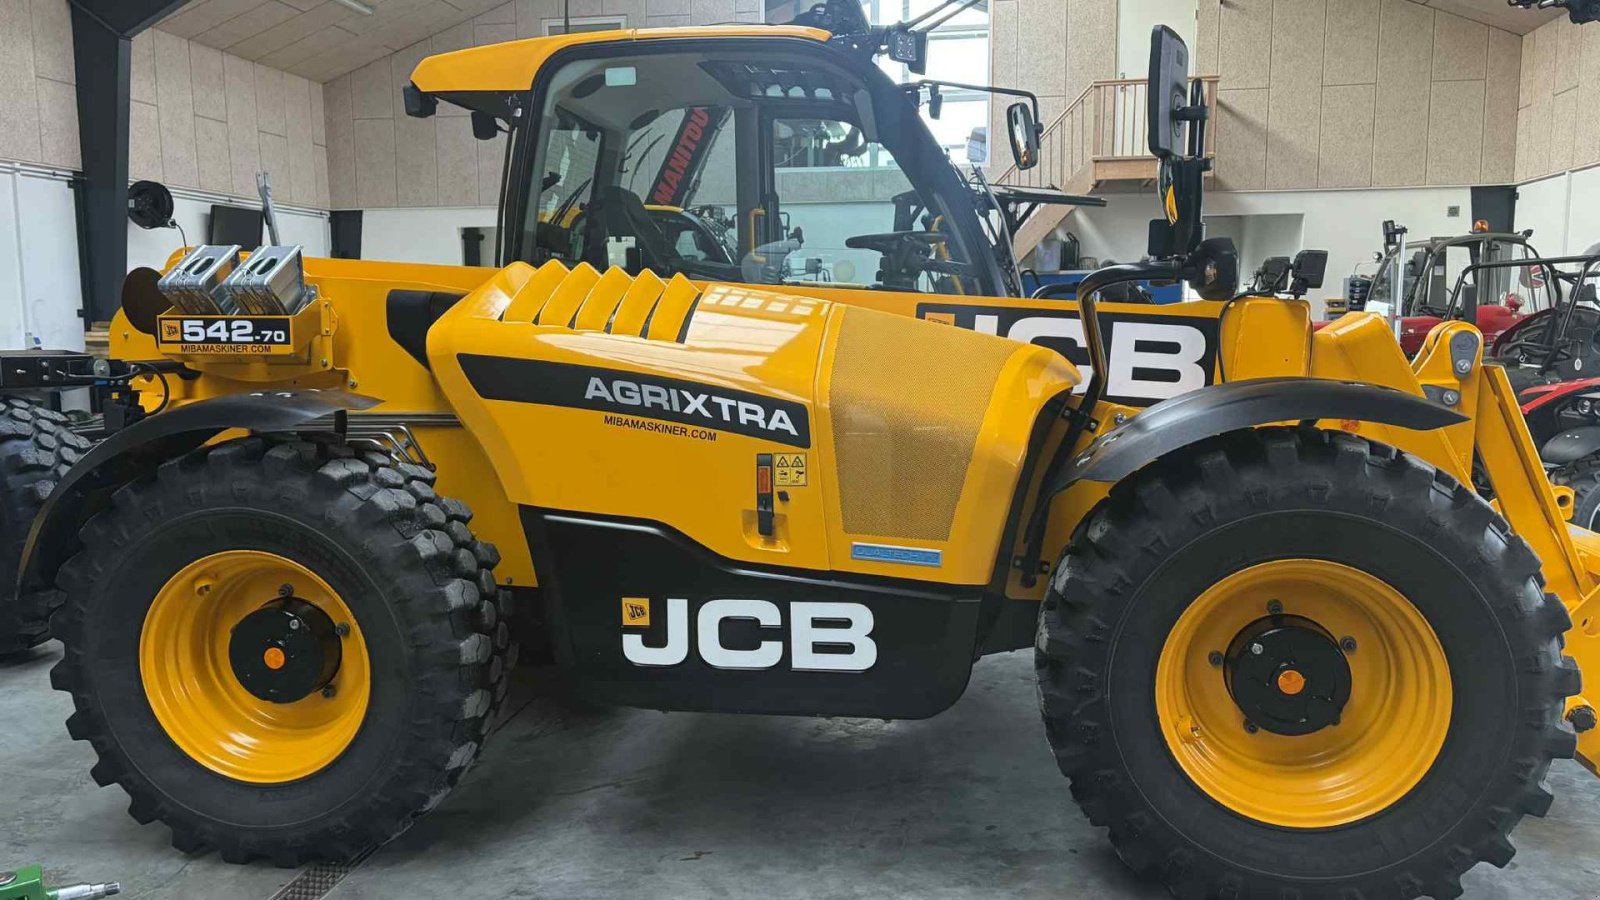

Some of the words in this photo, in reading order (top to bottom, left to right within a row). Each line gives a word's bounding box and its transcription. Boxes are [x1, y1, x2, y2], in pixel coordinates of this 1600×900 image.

[653, 108, 709, 203] MANITOU
[180, 344, 272, 353] MIBAMASKINER.COM
[182, 320, 286, 342] 542-70
[584, 376, 799, 436] AGRIXTRA
[603, 415, 717, 441] MIBAMASKINER.COM
[622, 598, 877, 671] JCB
